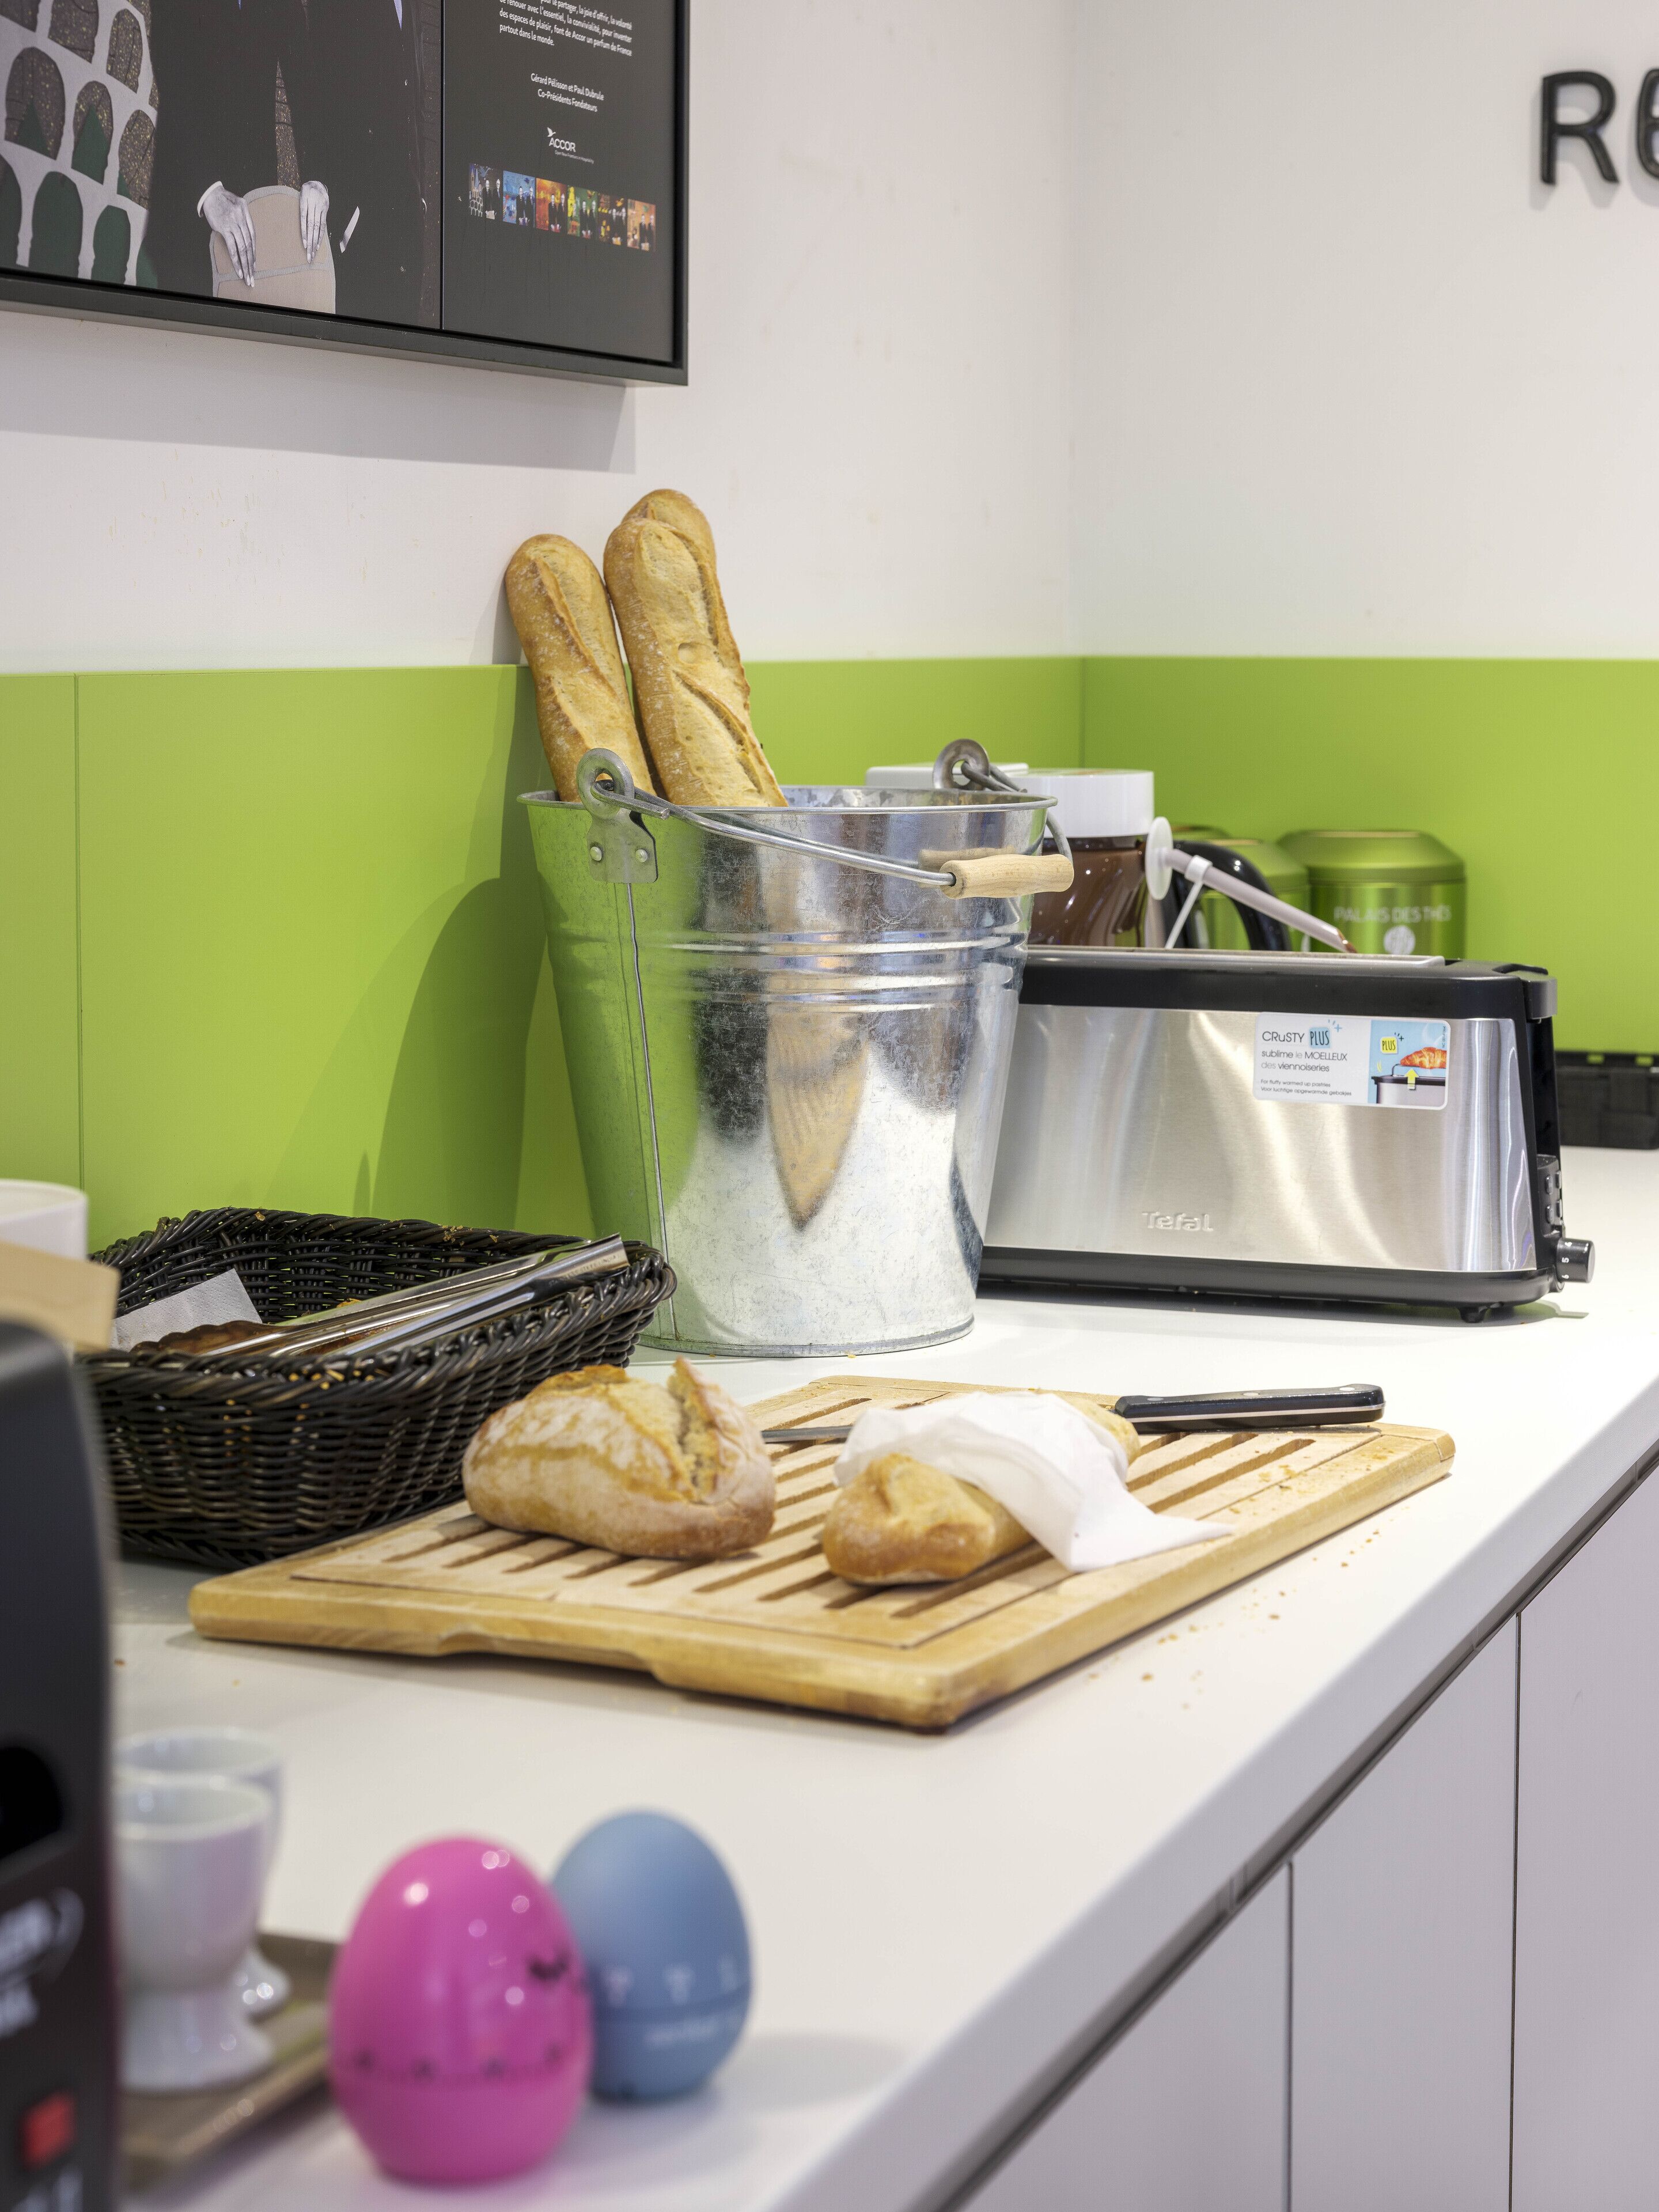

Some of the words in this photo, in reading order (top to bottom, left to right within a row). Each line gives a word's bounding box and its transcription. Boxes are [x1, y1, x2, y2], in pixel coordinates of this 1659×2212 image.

[507, 0, 526, 10] renouer
[527, 5, 539, 14] avec
[540, 5, 566, 24] l'essentiel,
[567, 14, 572, 24] la
[573, 19, 601, 35] convivialité,
[602, 28, 612, 37] pour
[613, 30, 632, 43] inventer
[557, 1, 578, 14] partager,
[579, 5, 584, 14] la
[583, 7, 592, 18] joie
[611, 15, 615, 25] la
[615, 18, 632, 30] volonté
[499, 7, 508, 18] des
[509, 13, 528, 24] espaces
[529, 17, 535, 26] de
[536, 19, 553, 33] plaisir,
[554, 25, 565, 36] font
[565, 28, 571, 37] de
[571, 31, 586, 42] Accor
[593, 39, 610, 48] parfum
[611, 42, 616, 52] de
[617, 44, 632, 56] France
[499, 24, 518, 35] partout
[518, 27, 531, 39] dans
[531, 31, 536, 41] le
[537, 36, 555, 46] monde.
[531, 73, 547, 85] Gérard
[548, 77, 568, 90] Pélisson
[573, 85, 585, 96] Paul
[585, 88, 604, 101] Dubrule
[537, 89, 572, 105] Co-Présidents
[572, 97, 598, 112] Fondateurs
[549, 138, 576, 153] ACCOR
[1334, 906, 1391, 923] PALAIS
[1392, 907, 1422, 923] DES
[1309, 1030, 1330, 1046] PLUS
[1382, 1039, 1396, 1051] PLUS
[1261, 1049, 1294, 1059] sublime
[1295, 1051, 1303, 1059] le
[1304, 1051, 1348, 1061] MOELLEUX
[1261, 1061, 1277, 1070] des
[1278, 1062, 1330, 1072] viennoiseries
[1142, 1211, 1214, 1232] Tefal
